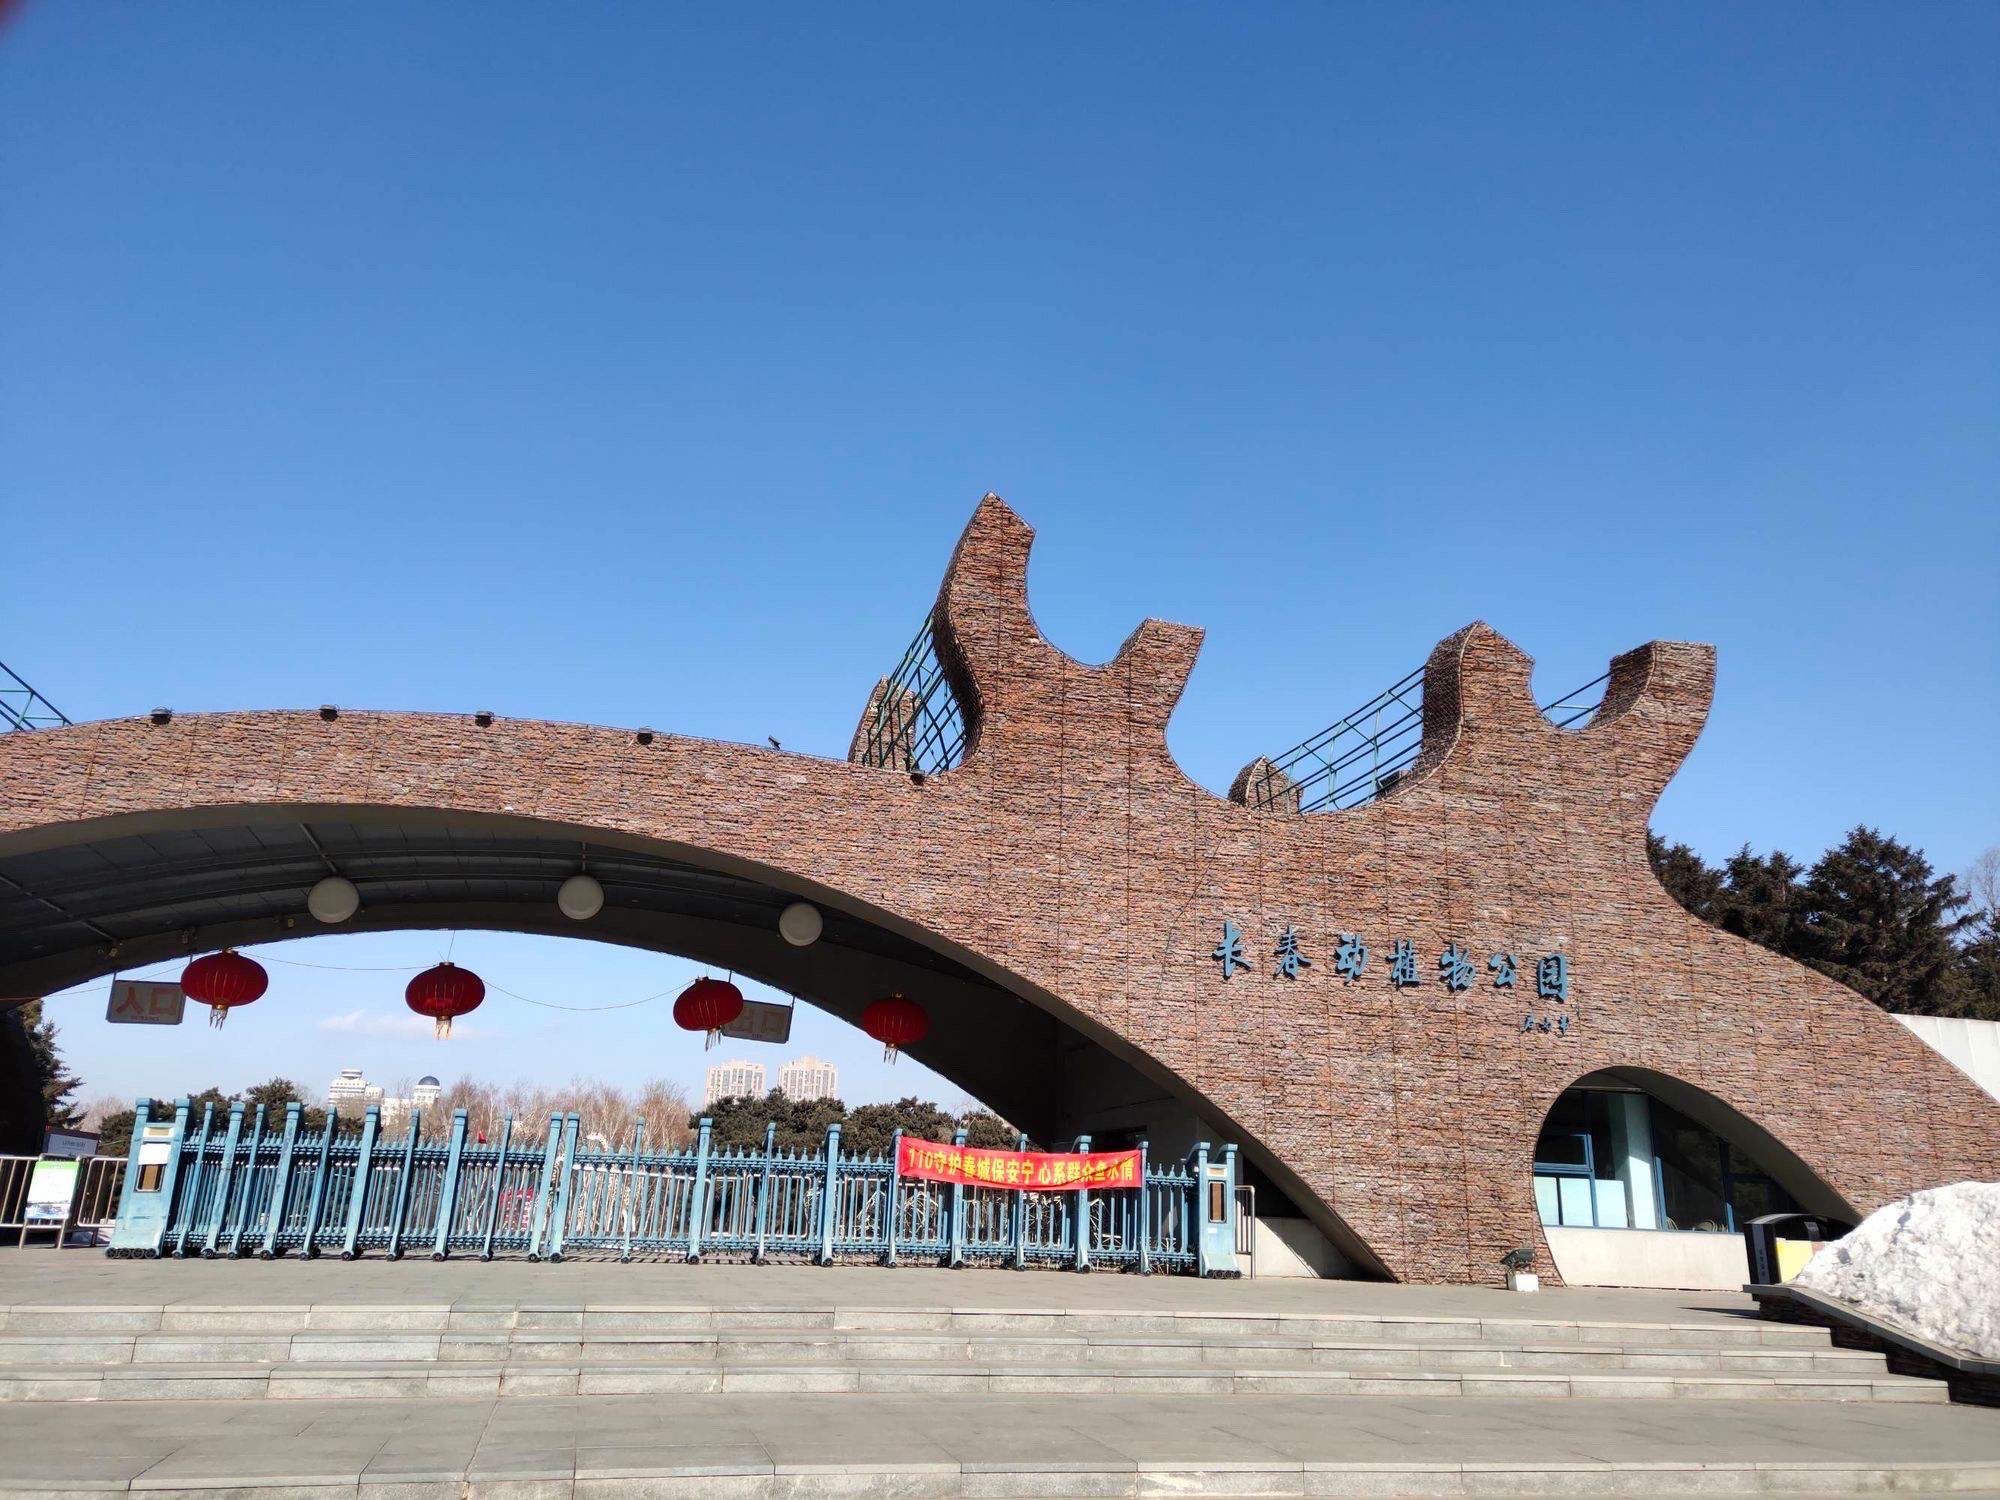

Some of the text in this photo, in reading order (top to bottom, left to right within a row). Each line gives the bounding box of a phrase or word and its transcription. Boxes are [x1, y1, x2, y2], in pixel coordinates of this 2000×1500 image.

[1212, 920, 1569, 1001] 长春动植物公园
